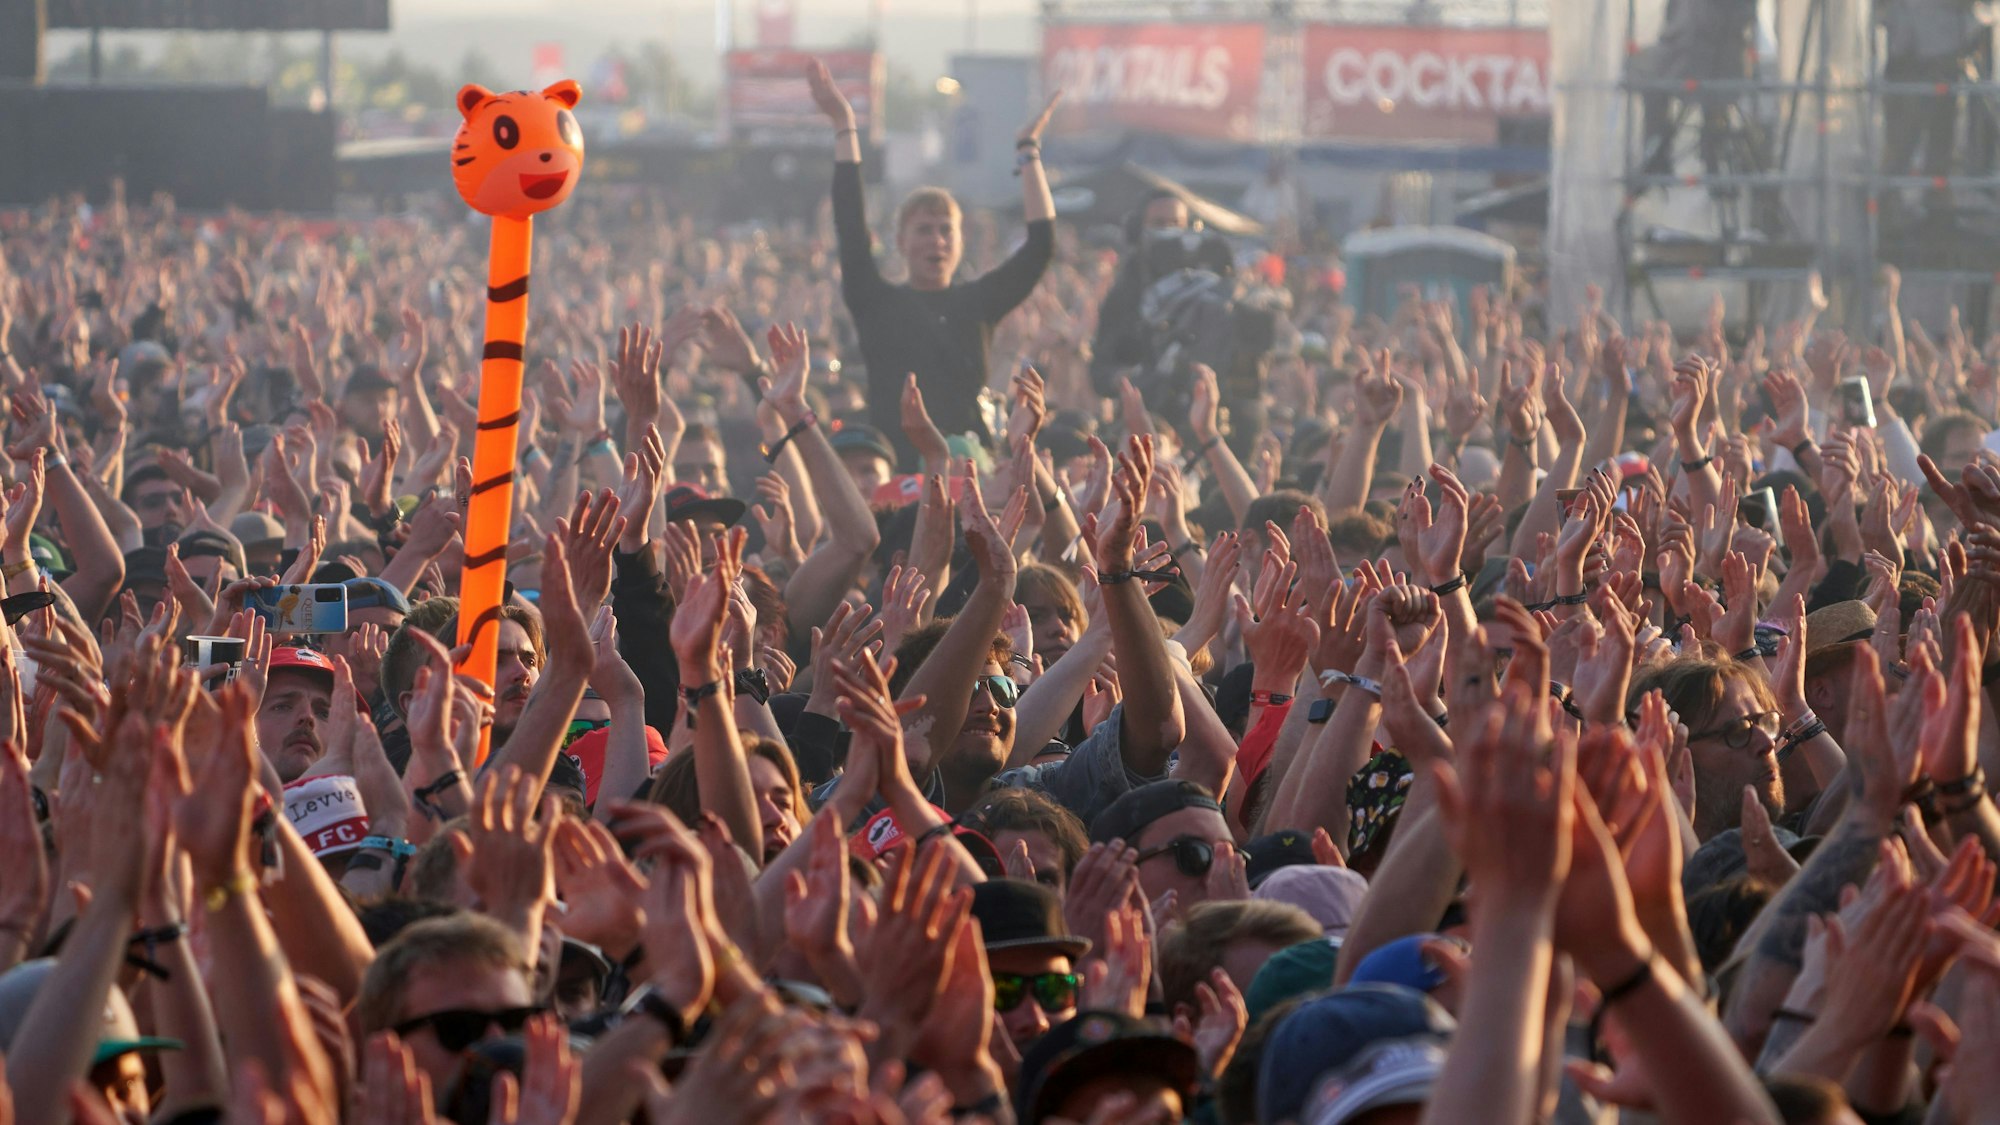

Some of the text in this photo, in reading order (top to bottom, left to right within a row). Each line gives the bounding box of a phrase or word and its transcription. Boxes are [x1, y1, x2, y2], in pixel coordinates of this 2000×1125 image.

[1325, 47, 1552, 110] COCKTA
[289, 789, 355, 822] Levve
[318, 824, 356, 848] FC
